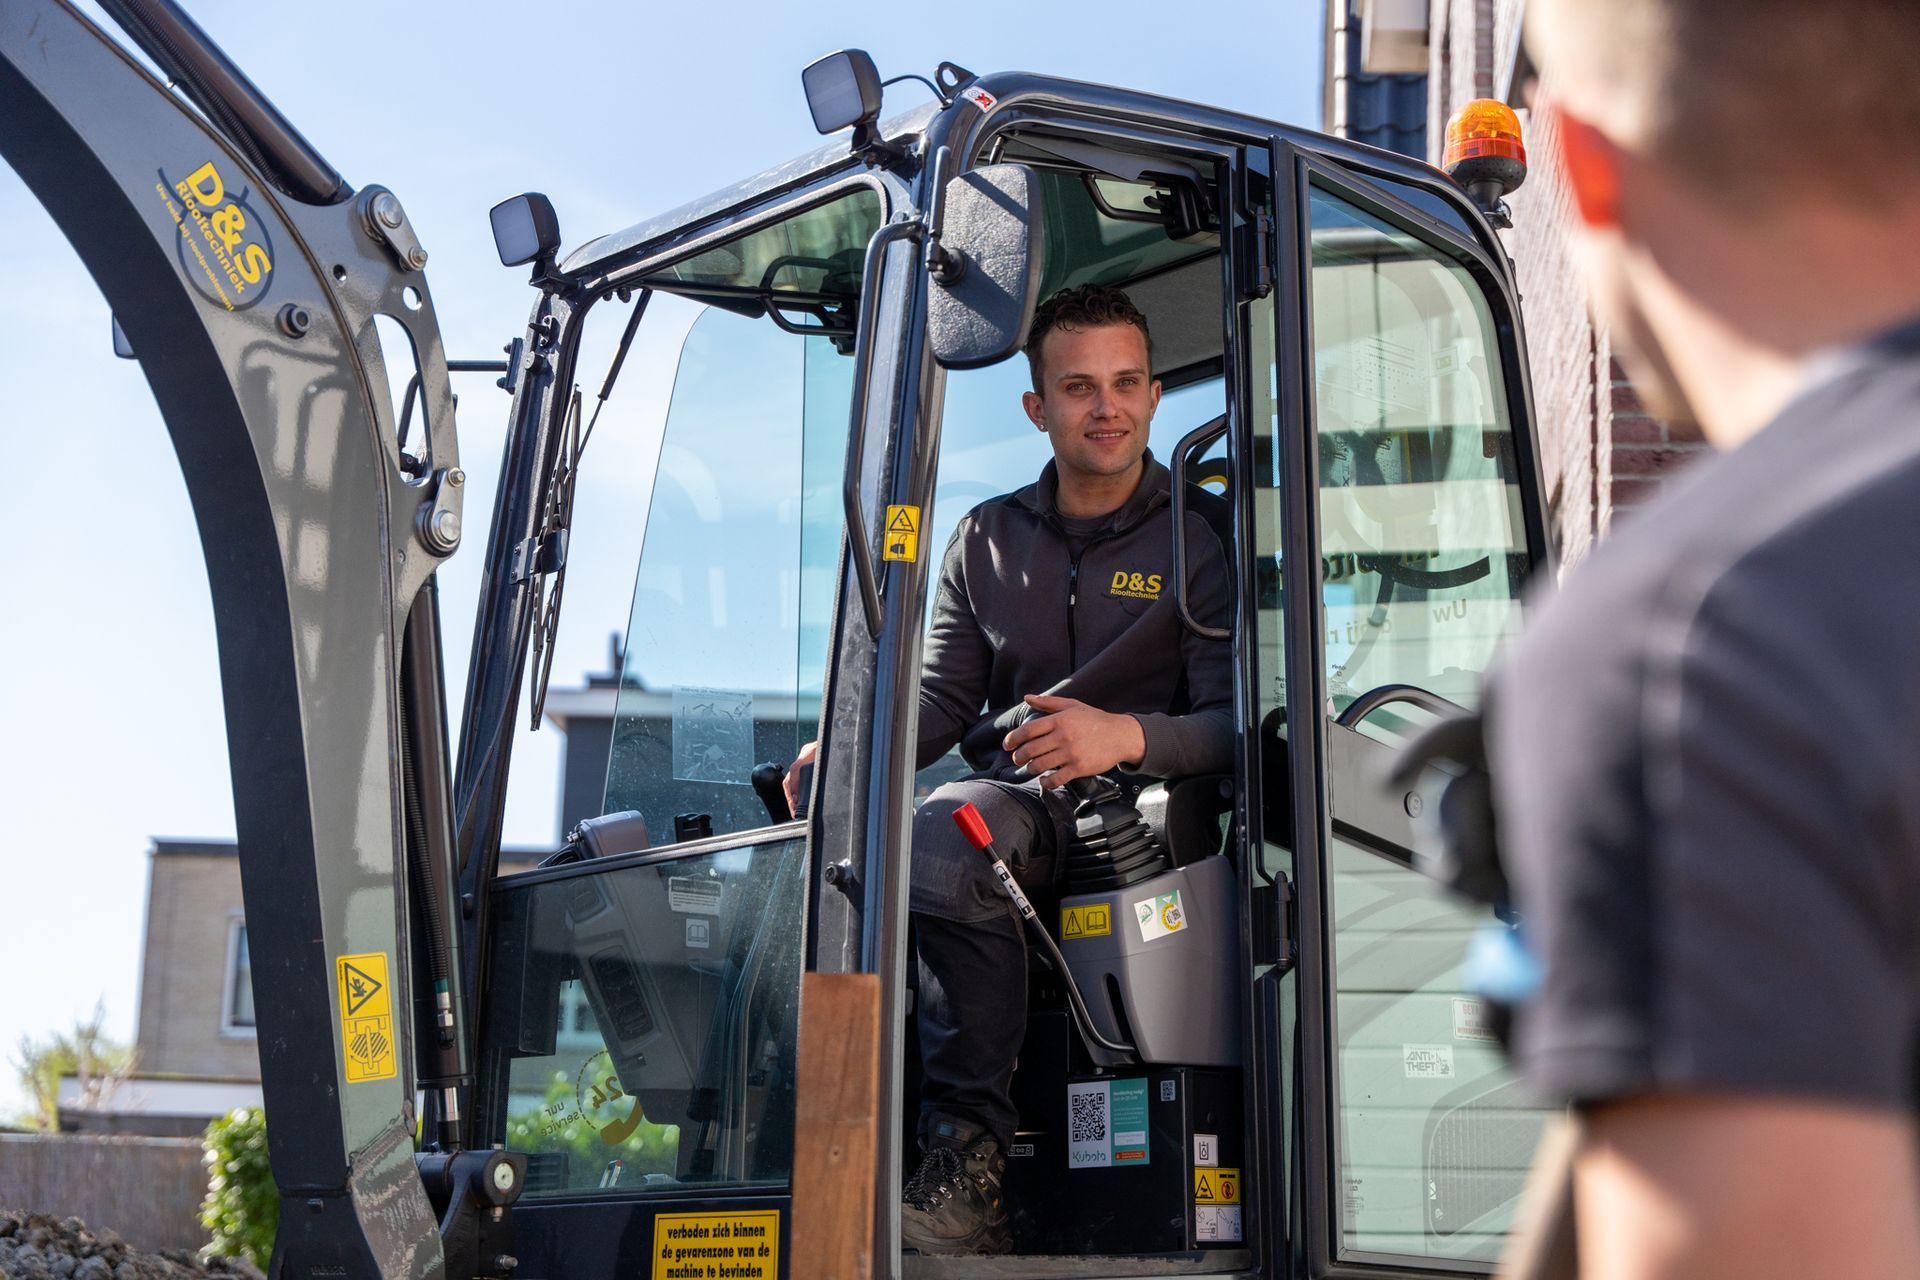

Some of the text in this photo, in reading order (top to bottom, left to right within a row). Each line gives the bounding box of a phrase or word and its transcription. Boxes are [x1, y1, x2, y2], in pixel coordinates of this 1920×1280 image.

[155, 183, 167, 200] Uw
[166, 201, 182, 223] held
[179, 223, 191, 238] bij
[186, 161, 272, 284] D&S
[175, 181, 246, 294] Riooltechniek
[1111, 571, 1162, 593] D&S
[1110, 588, 1160, 600] Riooltechniek
[1406, 1062, 1436, 1072] THEFT
[1072, 1150, 1107, 1163] Kubota
[667, 1221, 765, 1239] verboden zich binnen
[661, 1242, 770, 1263] de gevarenzone van de
[666, 1263, 763, 1279] machine te bevinden
